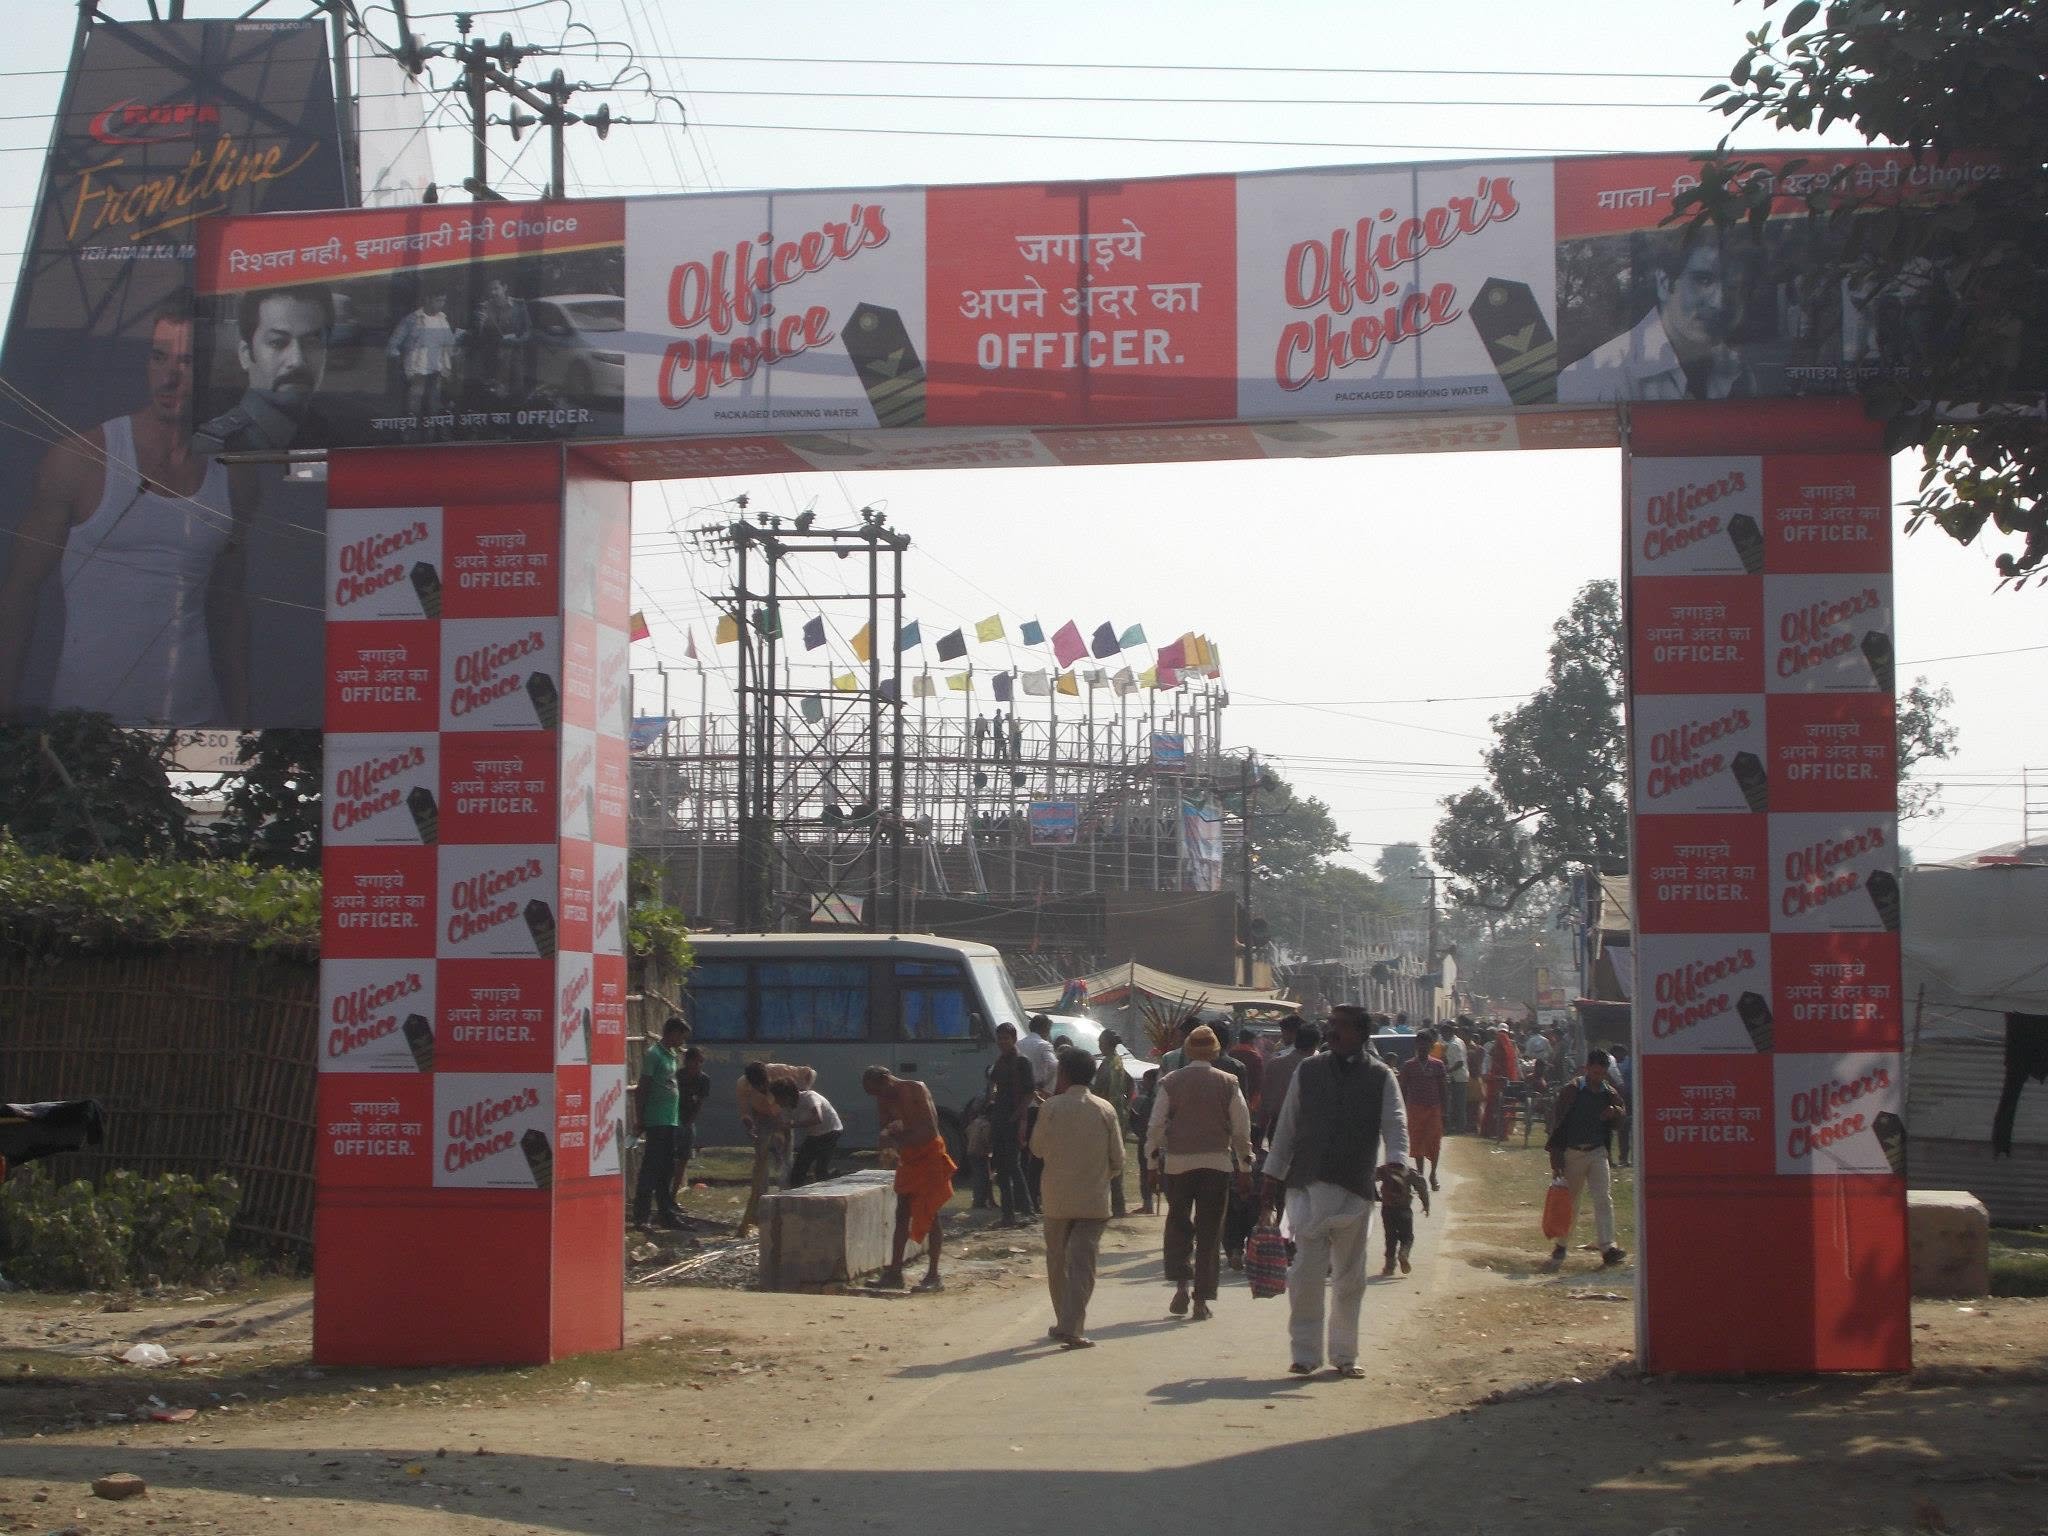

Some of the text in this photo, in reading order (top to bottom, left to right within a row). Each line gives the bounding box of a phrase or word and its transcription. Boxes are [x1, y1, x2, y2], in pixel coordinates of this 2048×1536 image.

[123, 104, 219, 124] RUPA
[68, 132, 319, 241] Frontline
[228, 250, 296, 273] रिश्वत
[355, 222, 453, 260] इमानदारी
[458, 217, 496, 243] मेरी
[501, 215, 578, 239] Choice
[1015, 218, 1147, 272] जगाइये
[1285, 176, 1519, 315] Officer's
[667, 203, 890, 335] Officer's
[959, 273, 1202, 320] अपने अंदर का
[658, 303, 835, 409] Choice
[977, 328, 1185, 370] OFFICER.
[1275, 281, 1463, 391] Choice
[714, 408, 859, 420] PACKAGED DRINKING WATER
[1335, 386, 1489, 401] PACKAGED DRINKING WATER
[492, 412, 512, 425] का
[517, 408, 595, 426] OFFICER.
[1647, 472, 1747, 526] Officer's
[339, 523, 428, 574] Officer's
[1643, 516, 1721, 561] Choice
[1785, 526, 1875, 543] OFFICER.
[460, 572, 541, 588] OFFICER.
[527, 553, 548, 566] का
[335, 564, 405, 607] Choice
[1778, 590, 1878, 644] Officer's
[409, 668, 429, 681] का
[453, 632, 543, 684] Officer's
[1654, 646, 1745, 663] OFFICER.
[1775, 633, 1852, 679] Choice
[342, 687, 423, 703] OFFICER.
[449, 673, 519, 717] Choice
[1650, 709, 1750, 763] Officer's
[337, 747, 425, 799] Officer's
[525, 779, 546, 792] का
[1646, 753, 1725, 799] Choice
[1788, 765, 1879, 781] OFFICER.
[333, 788, 401, 832] Choice
[456, 798, 540, 814] OFFICER.
[1783, 828, 1883, 883] Officer's
[406, 894, 426, 907] का
[450, 859, 542, 911] Officer's
[1658, 885, 1750, 902] OFFICER.
[1780, 872, 1858, 918] Choice
[339, 913, 420, 929] OFFICER.
[446, 901, 517, 945] Choice
[1654, 949, 1756, 1004] Officer's
[333, 974, 422, 1026] Officer's
[522, 1008, 543, 1021] का
[1651, 993, 1731, 1039] Choice
[1794, 1005, 1885, 1021] OFFICER.
[328, 1015, 398, 1059] Choice
[453, 1027, 537, 1043] OFFICER.
[447, 1088, 539, 1140] Officer's
[1789, 1068, 1888, 1124] Officer's
[334, 1141, 416, 1157] OFFICER.
[402, 1122, 422, 1135] का
[1663, 1126, 1755, 1143] OFFICER.
[1785, 1113, 1863, 1160] Choice
[442, 1129, 514, 1174] Choice
